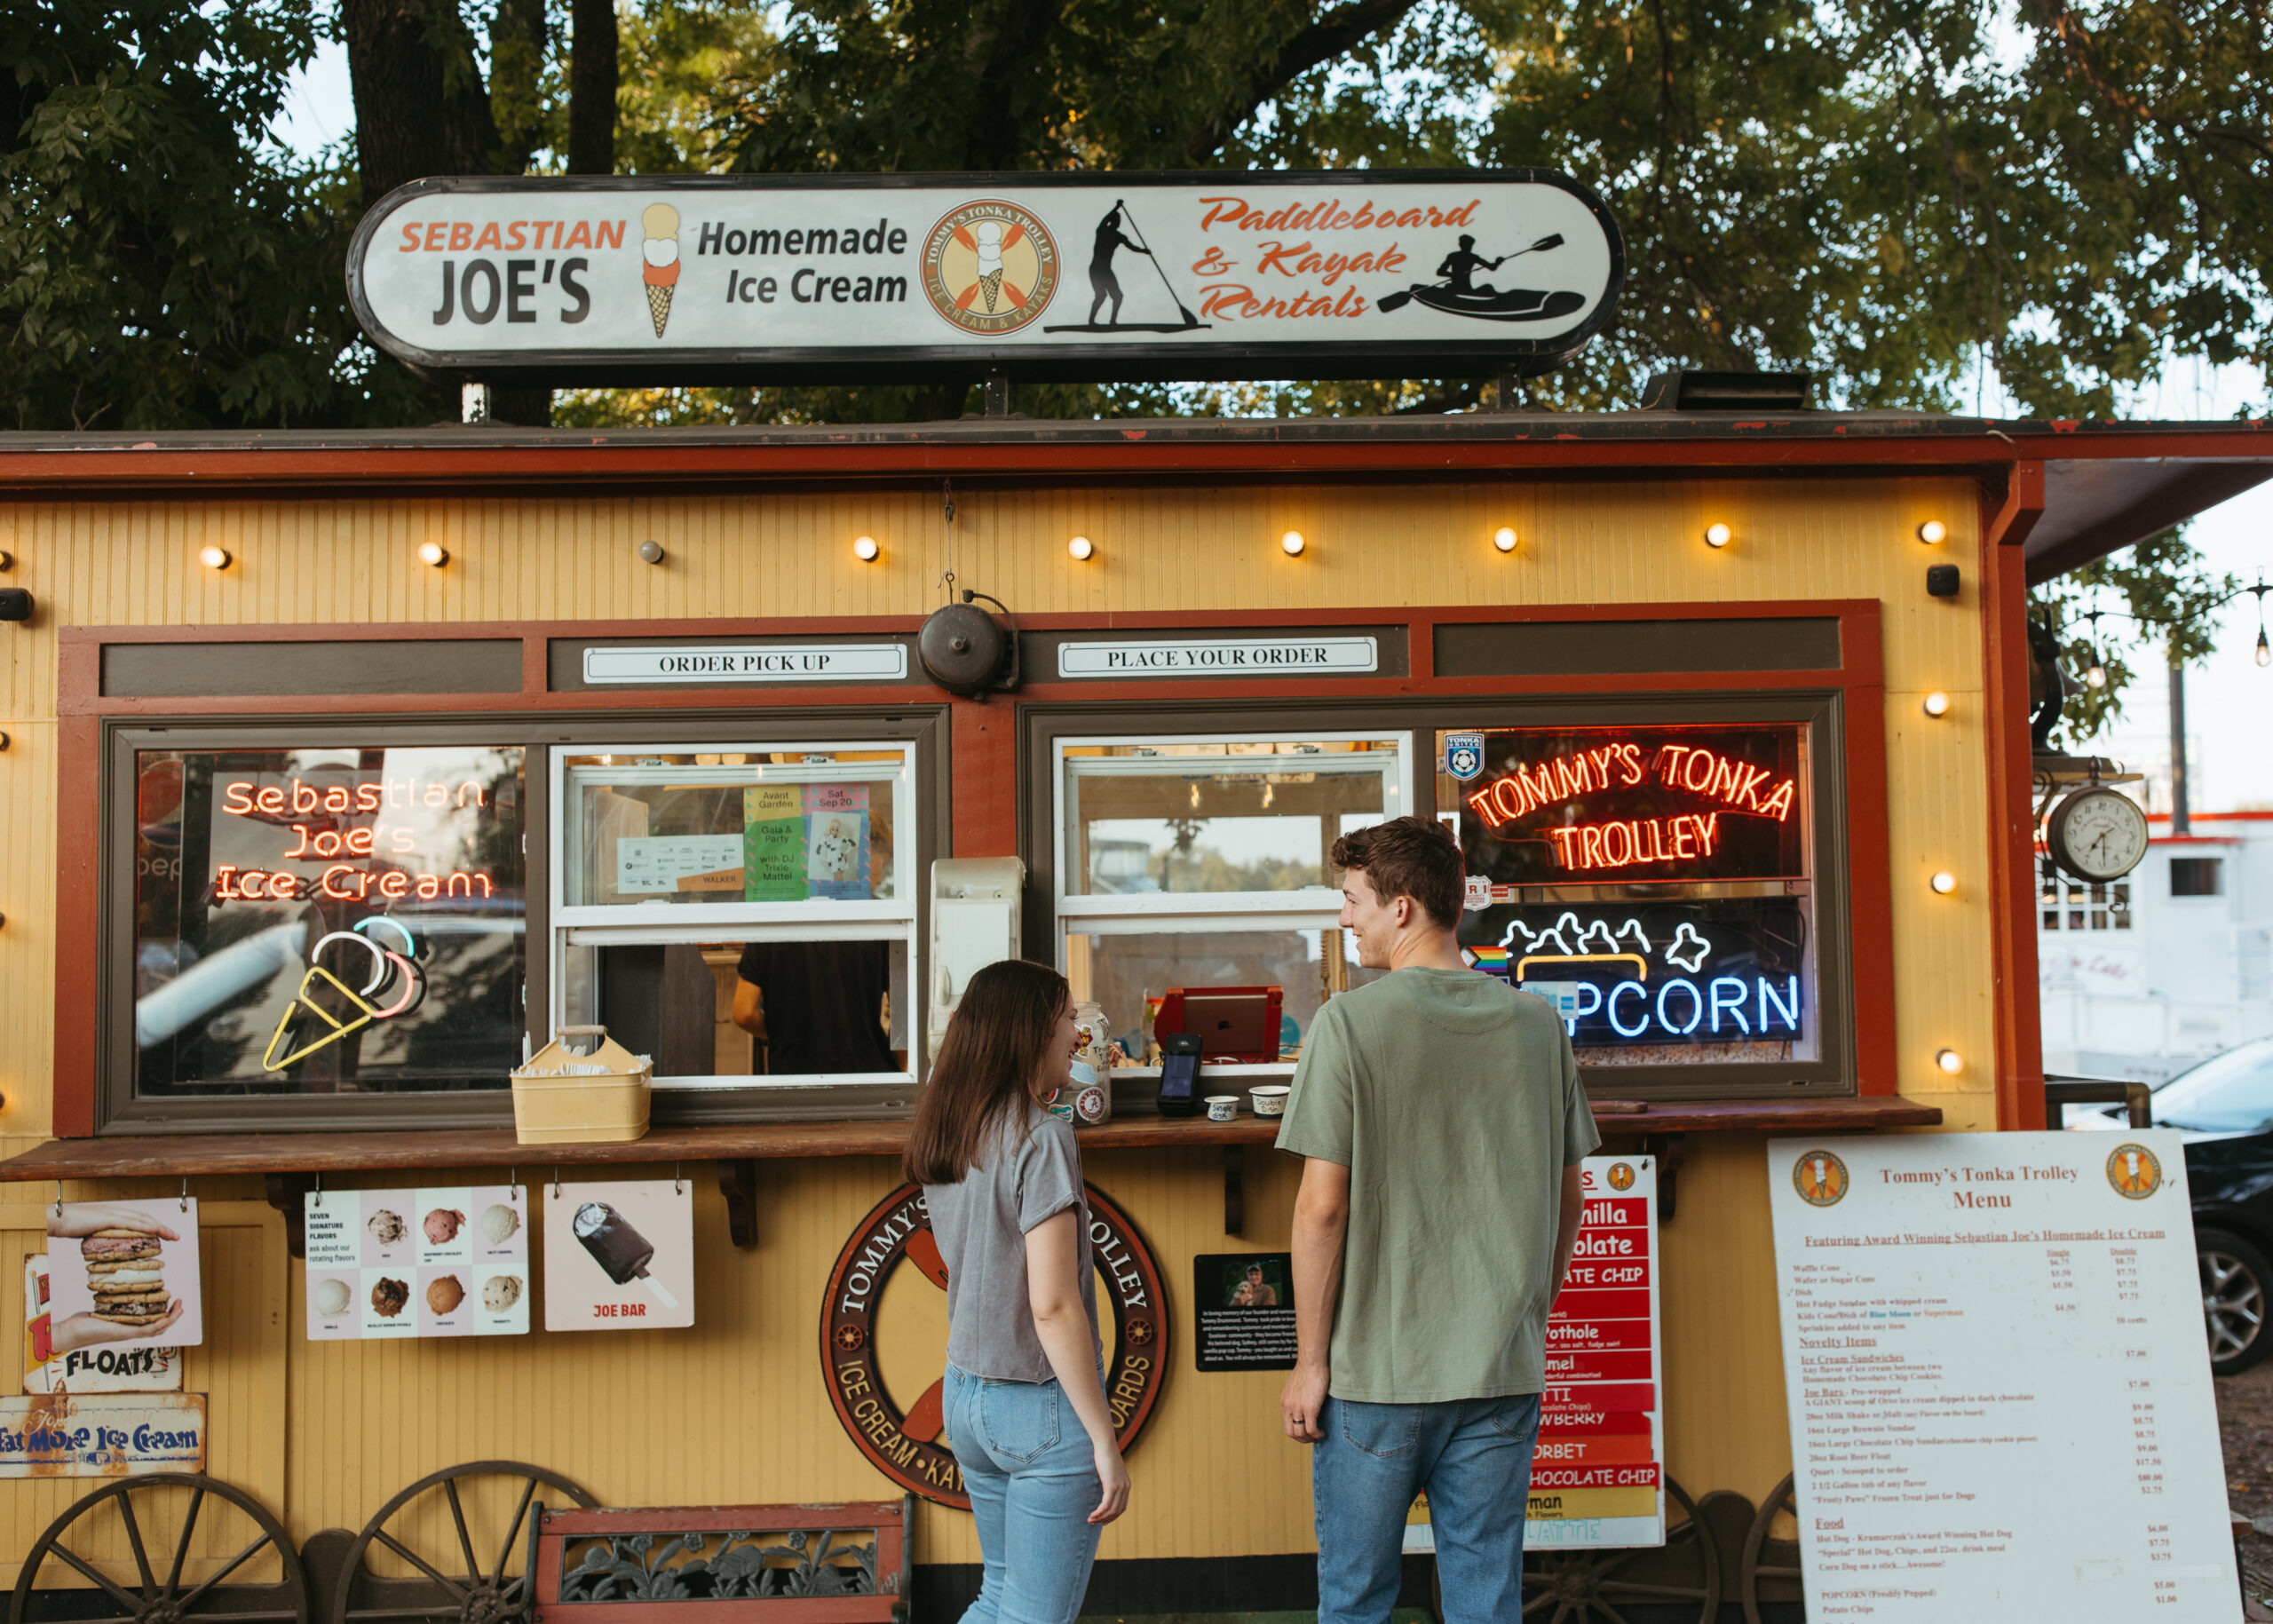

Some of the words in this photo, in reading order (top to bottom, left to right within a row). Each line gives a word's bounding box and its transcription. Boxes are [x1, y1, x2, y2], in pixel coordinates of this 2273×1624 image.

[1199, 197, 1481, 233] Paddleboard
[398, 219, 627, 253] SEBASTIAN
[697, 218, 907, 256] Homemade
[927, 212, 966, 265] TOMMY'S
[966, 205, 1012, 219] TONKA
[1016, 212, 1054, 264] TROLLEY
[1192, 246, 1238, 276] &
[1258, 241, 1406, 286] Kayak
[432, 257, 591, 326] JOE'S
[726, 269, 778, 304] Ice
[790, 267, 907, 304] Cream
[928, 278, 944, 301] ICE
[944, 303, 991, 329] CREAM
[999, 318, 1008, 329] &
[1014, 276, 1053, 322] KAYAKS
[1200, 283, 1370, 321] Rentals
[660, 656, 735, 672] ORDER
[743, 655, 796, 671] PICK
[803, 654, 830, 670] UP
[1108, 650, 1178, 667] PLACE
[1185, 649, 1246, 666] YOUR
[1253, 647, 1328, 664] ORDER
[221, 778, 486, 815] Sebastian
[828, 789, 843, 798] Sat
[1469, 742, 1644, 828] TOMMY'S
[1661, 744, 1794, 822] TONKA
[819, 799, 838, 808] Sep
[284, 823, 416, 859] Joe's
[761, 826, 783, 835] Gala
[764, 836, 789, 844] Party
[1554, 812, 1717, 871] TROLLEY
[139, 858, 181, 882] pep
[760, 854, 780, 863] with
[782, 854, 795, 863] DJ
[216, 865, 297, 899] Ice
[321, 864, 493, 899] Cream
[702, 875, 736, 884] WALKER
[1568, 975, 1799, 1037] PCORN
[1879, 1167, 1958, 1186] Tommy's
[1961, 1167, 2016, 1182] Tonka
[2019, 1166, 2079, 1184] Trolley
[1953, 1191, 2012, 1209] Menu
[1581, 1201, 1628, 1225] nilla
[1573, 1232, 1634, 1256] olate
[1805, 1234, 1861, 1247] Featuring
[1865, 1233, 1900, 1245] Award
[1904, 1232, 1952, 1244] Winning
[1954, 1232, 2008, 1243] Sebastian
[2011, 1231, 2039, 1242] Joe's
[2042, 1230, 2105, 1241] Homemade
[2109, 1229, 2125, 1240] Ice
[2128, 1228, 2166, 1240] Cream
[309, 1255, 334, 1264] rotating
[842, 1196, 930, 1313] TOMMY'S
[1088, 1209, 1147, 1309] OLLEY
[2047, 1248, 2071, 1258] Single
[2110, 1248, 2137, 1256] Double
[1602, 1267, 1643, 1283] CHIP
[593, 1305, 618, 1319] JOE
[621, 1303, 646, 1317] BAR
[1799, 1336, 1841, 1349] Novelty
[1845, 1335, 1877, 1348] Items
[66, 1348, 154, 1377] FLOATS
[1801, 1355, 1814, 1366] Ice
[1818, 1354, 1848, 1365] Cream
[1850, 1353, 1905, 1364] Sandwiches
[838, 1359, 871, 1400] ICE
[1111, 1354, 1150, 1430] OARDS
[1803, 1388, 1820, 1398] Joe
[1822, 1387, 1845, 1398] Bars
[1568, 1403, 1591, 1412] Chips)
[27, 1427, 91, 1453] More
[97, 1426, 129, 1450] Ice
[133, 1423, 199, 1453] Cream
[854, 1398, 918, 1469] CREAM
[1532, 1443, 1587, 1460] ORBET
[924, 1457, 964, 1493] KAY
[1530, 1470, 1615, 1485] HOCOLATE
[1617, 1469, 1657, 1485] CHIP
[1815, 1517, 1845, 1530] Food
[1821, 1590, 1866, 1600] POPCORN
